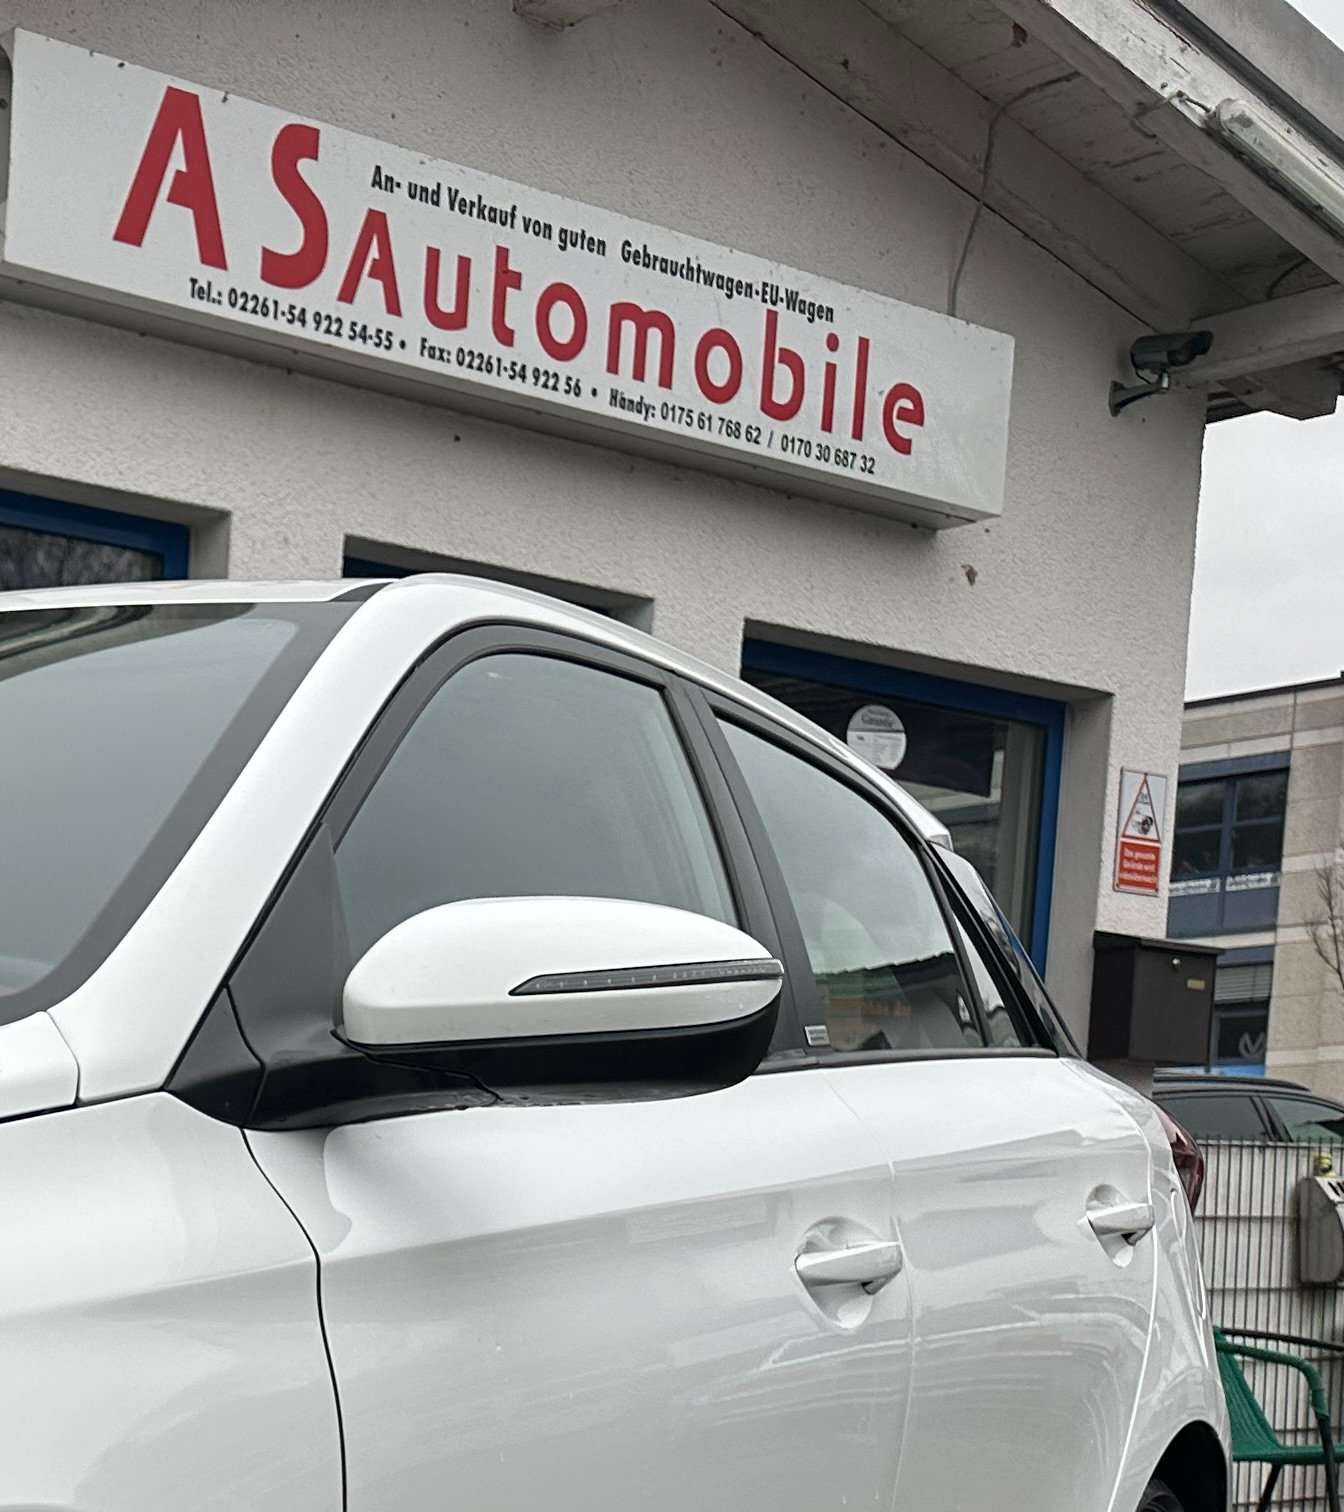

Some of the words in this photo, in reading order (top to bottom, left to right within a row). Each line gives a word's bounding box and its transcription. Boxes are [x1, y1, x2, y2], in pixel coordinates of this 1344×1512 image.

[370, 164, 402, 194] An-
[407, 182, 441, 208] und
[447, 186, 516, 230] Verkauf
[522, 214, 552, 241] von
[558, 226, 607, 257] guten
[189, 276, 223, 306] Tel.:
[227, 286, 308, 328] 02261-54
[312, 310, 344, 339] 922
[347, 320, 393, 351] 54-55
[419, 337, 452, 363] Fax:
[455, 347, 528, 384] 02261-54
[531, 367, 560, 393] 922
[563, 375, 582, 398] 56
[661, 401, 695, 428] 0175
[696, 411, 714, 433] 61
[717, 416, 742, 440] 768
[745, 424, 762, 446] 62
[780, 433, 812, 459] 0170
[815, 441, 831, 464] 30
[834, 447, 858, 470] 687
[860, 454, 876, 476] 32
